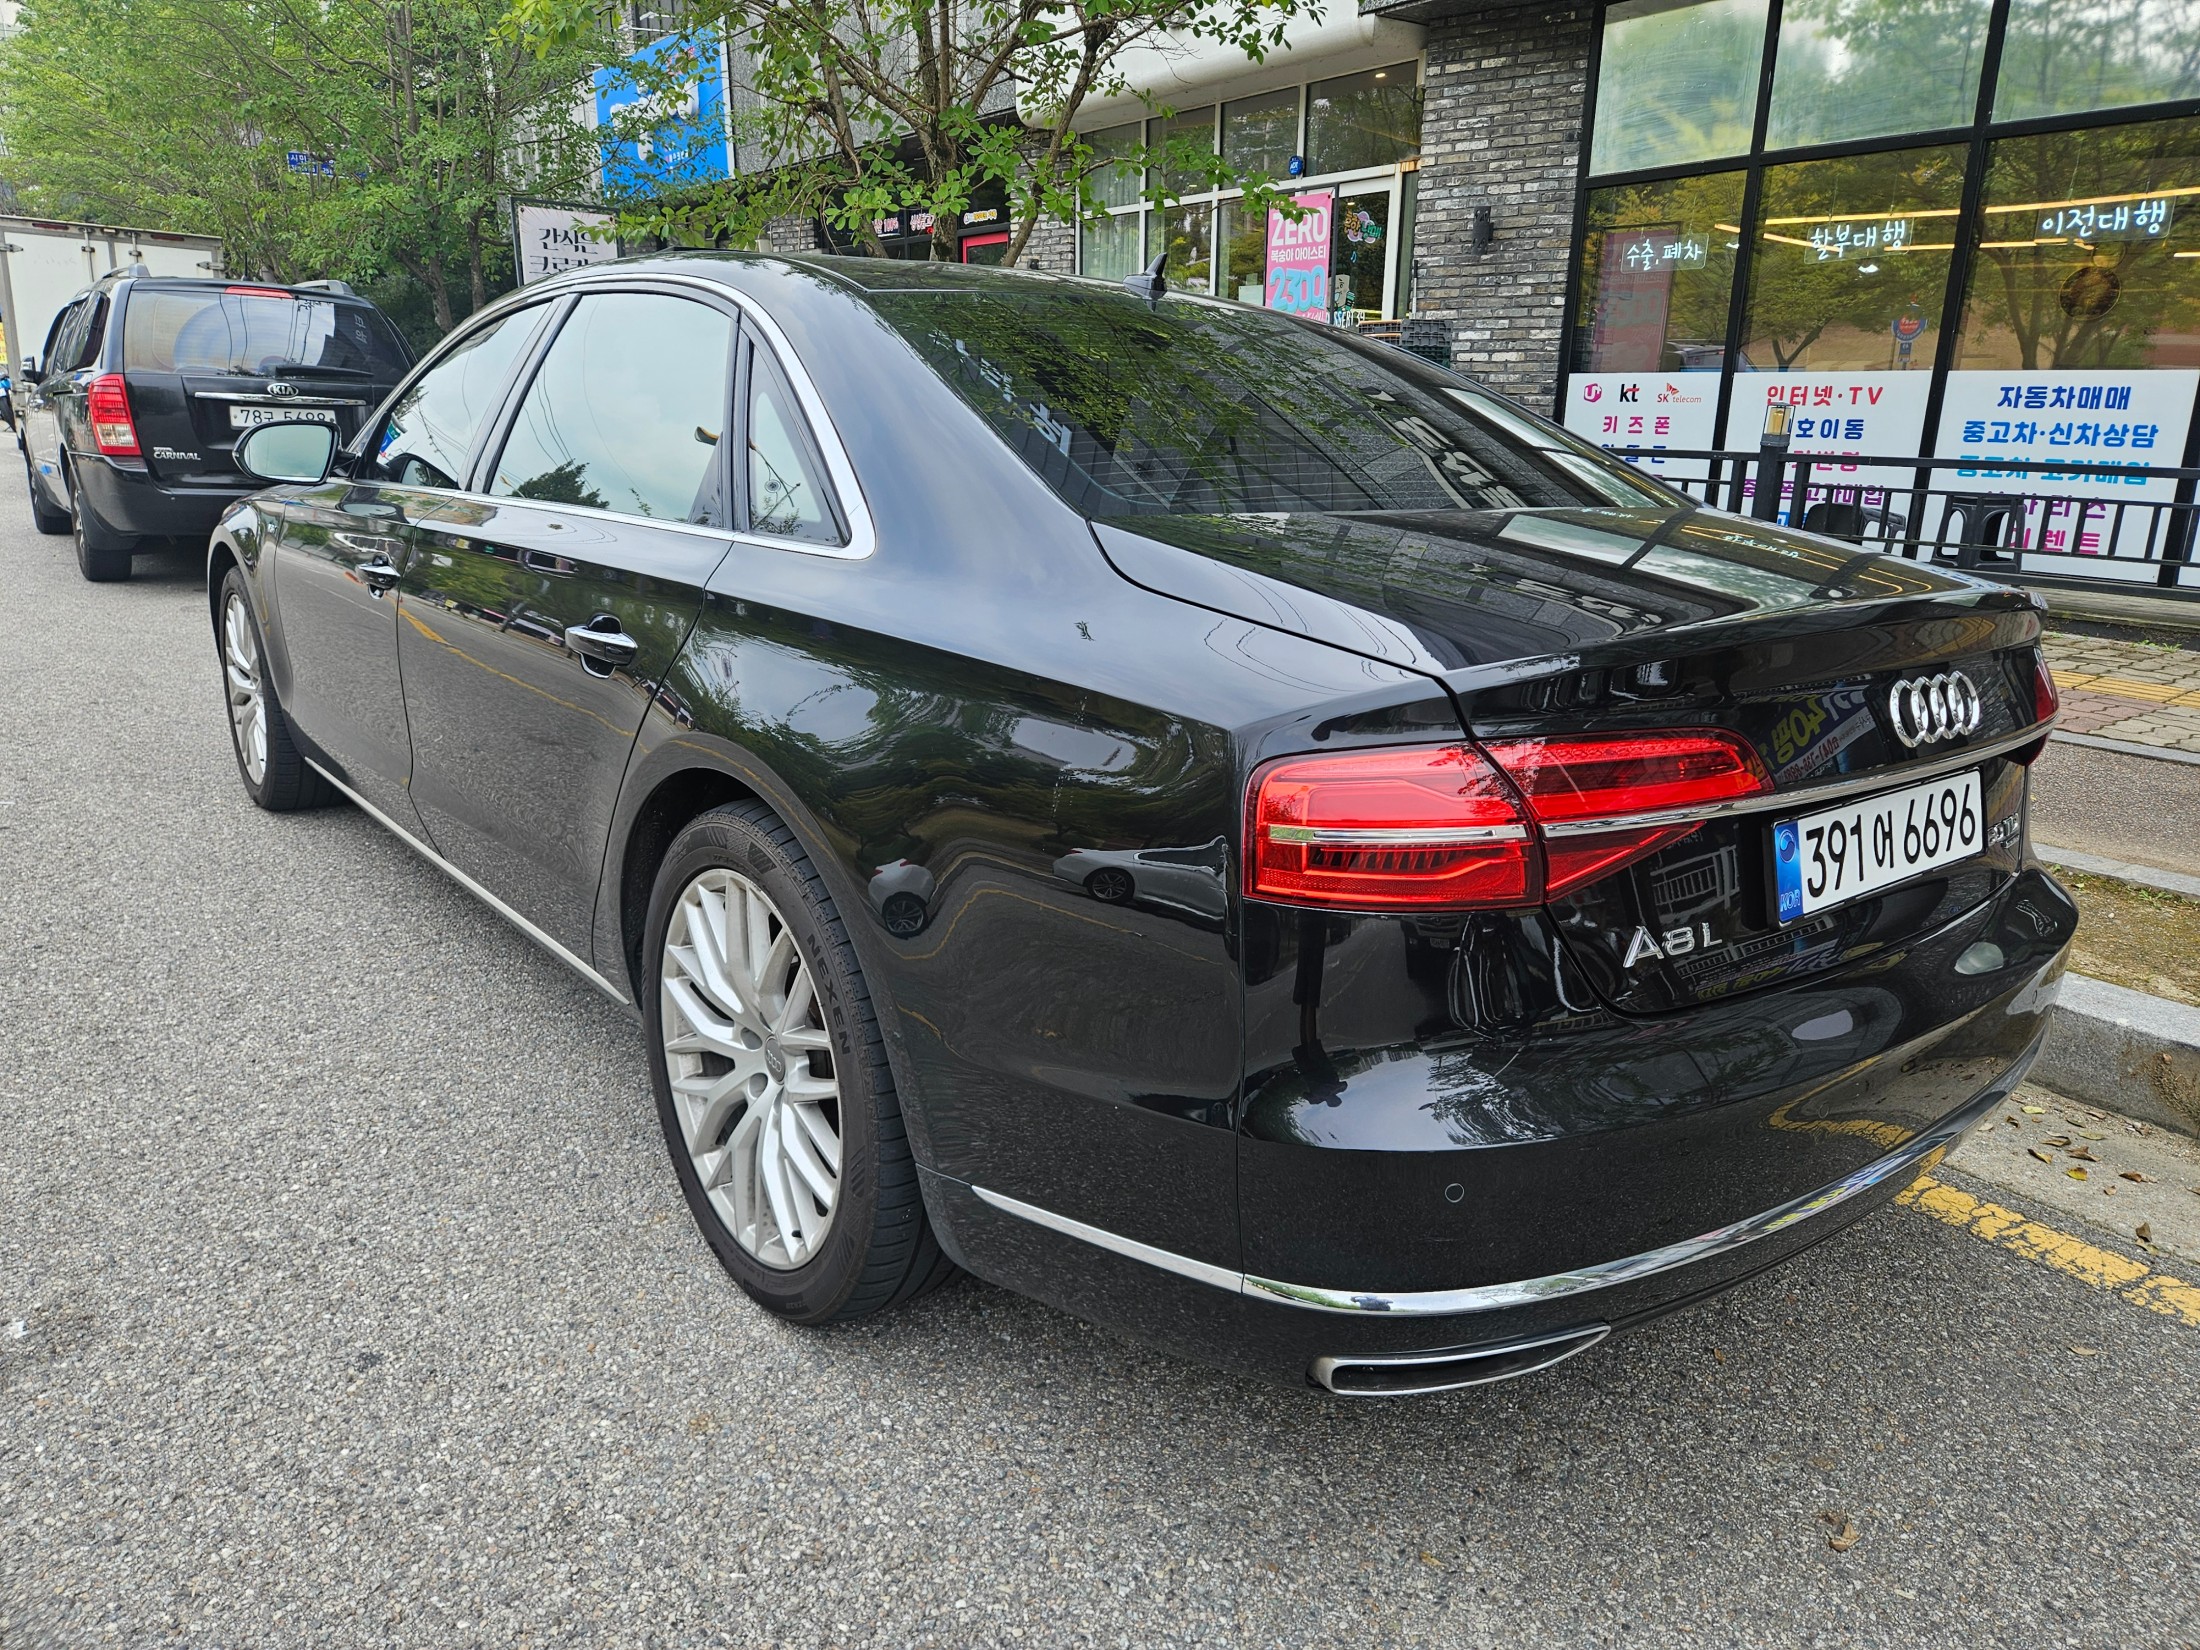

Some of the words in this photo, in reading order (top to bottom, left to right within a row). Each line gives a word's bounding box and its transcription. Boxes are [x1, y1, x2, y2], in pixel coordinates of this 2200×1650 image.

[1271, 207, 1328, 246] ZERO
[2042, 200, 2166, 236] 이전대행
[539, 227, 599, 254] 간식은
[1662, 239, 1703, 261] 폐차
[1811, 219, 1906, 261] 할부대행
[1271, 249, 1294, 263] 복숭아
[1295, 246, 1327, 261] 아이스티
[1270, 265, 1326, 313] 2300
[1325, 309, 1355, 328] DSSERT
[272, 385, 294, 395] KIA
[1620, 383, 1640, 403] kt
[1657, 393, 1669, 403] SK
[1672, 394, 1702, 403] telecom
[1997, 386, 2132, 410] 자동차매매
[1788, 418, 1864, 440] 호이동
[1963, 421, 2159, 449] 중고차·신차상담
[153, 451, 201, 461] CARNIVAL
[1903, 783, 1976, 865] 6696
[807, 933, 851, 1056] NEXEN
